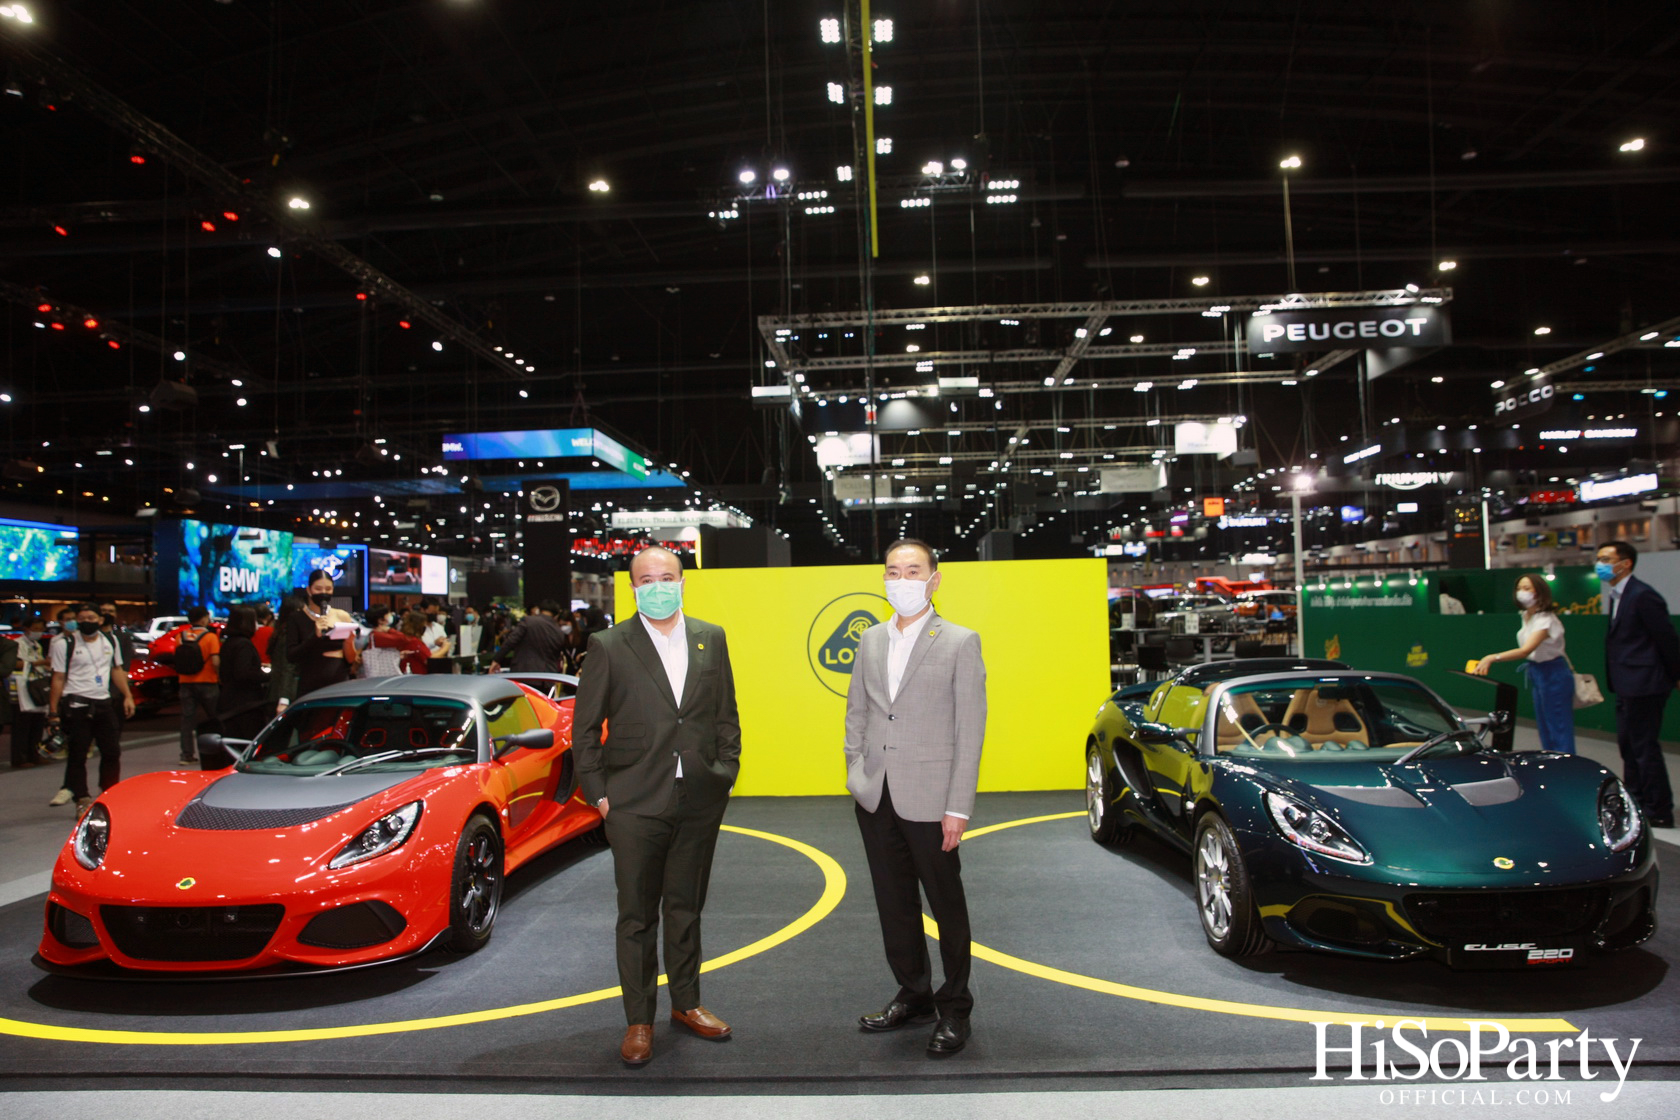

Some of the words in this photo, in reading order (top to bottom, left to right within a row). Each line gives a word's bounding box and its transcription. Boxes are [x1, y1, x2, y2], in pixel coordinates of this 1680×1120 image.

[1263, 318, 1427, 342] PEUGEOT
[1495, 385, 1554, 416] POCCO
[219, 566, 260, 593] BMW
[1464, 942, 1537, 951] ELISE
[1527, 948, 1574, 960] 220
